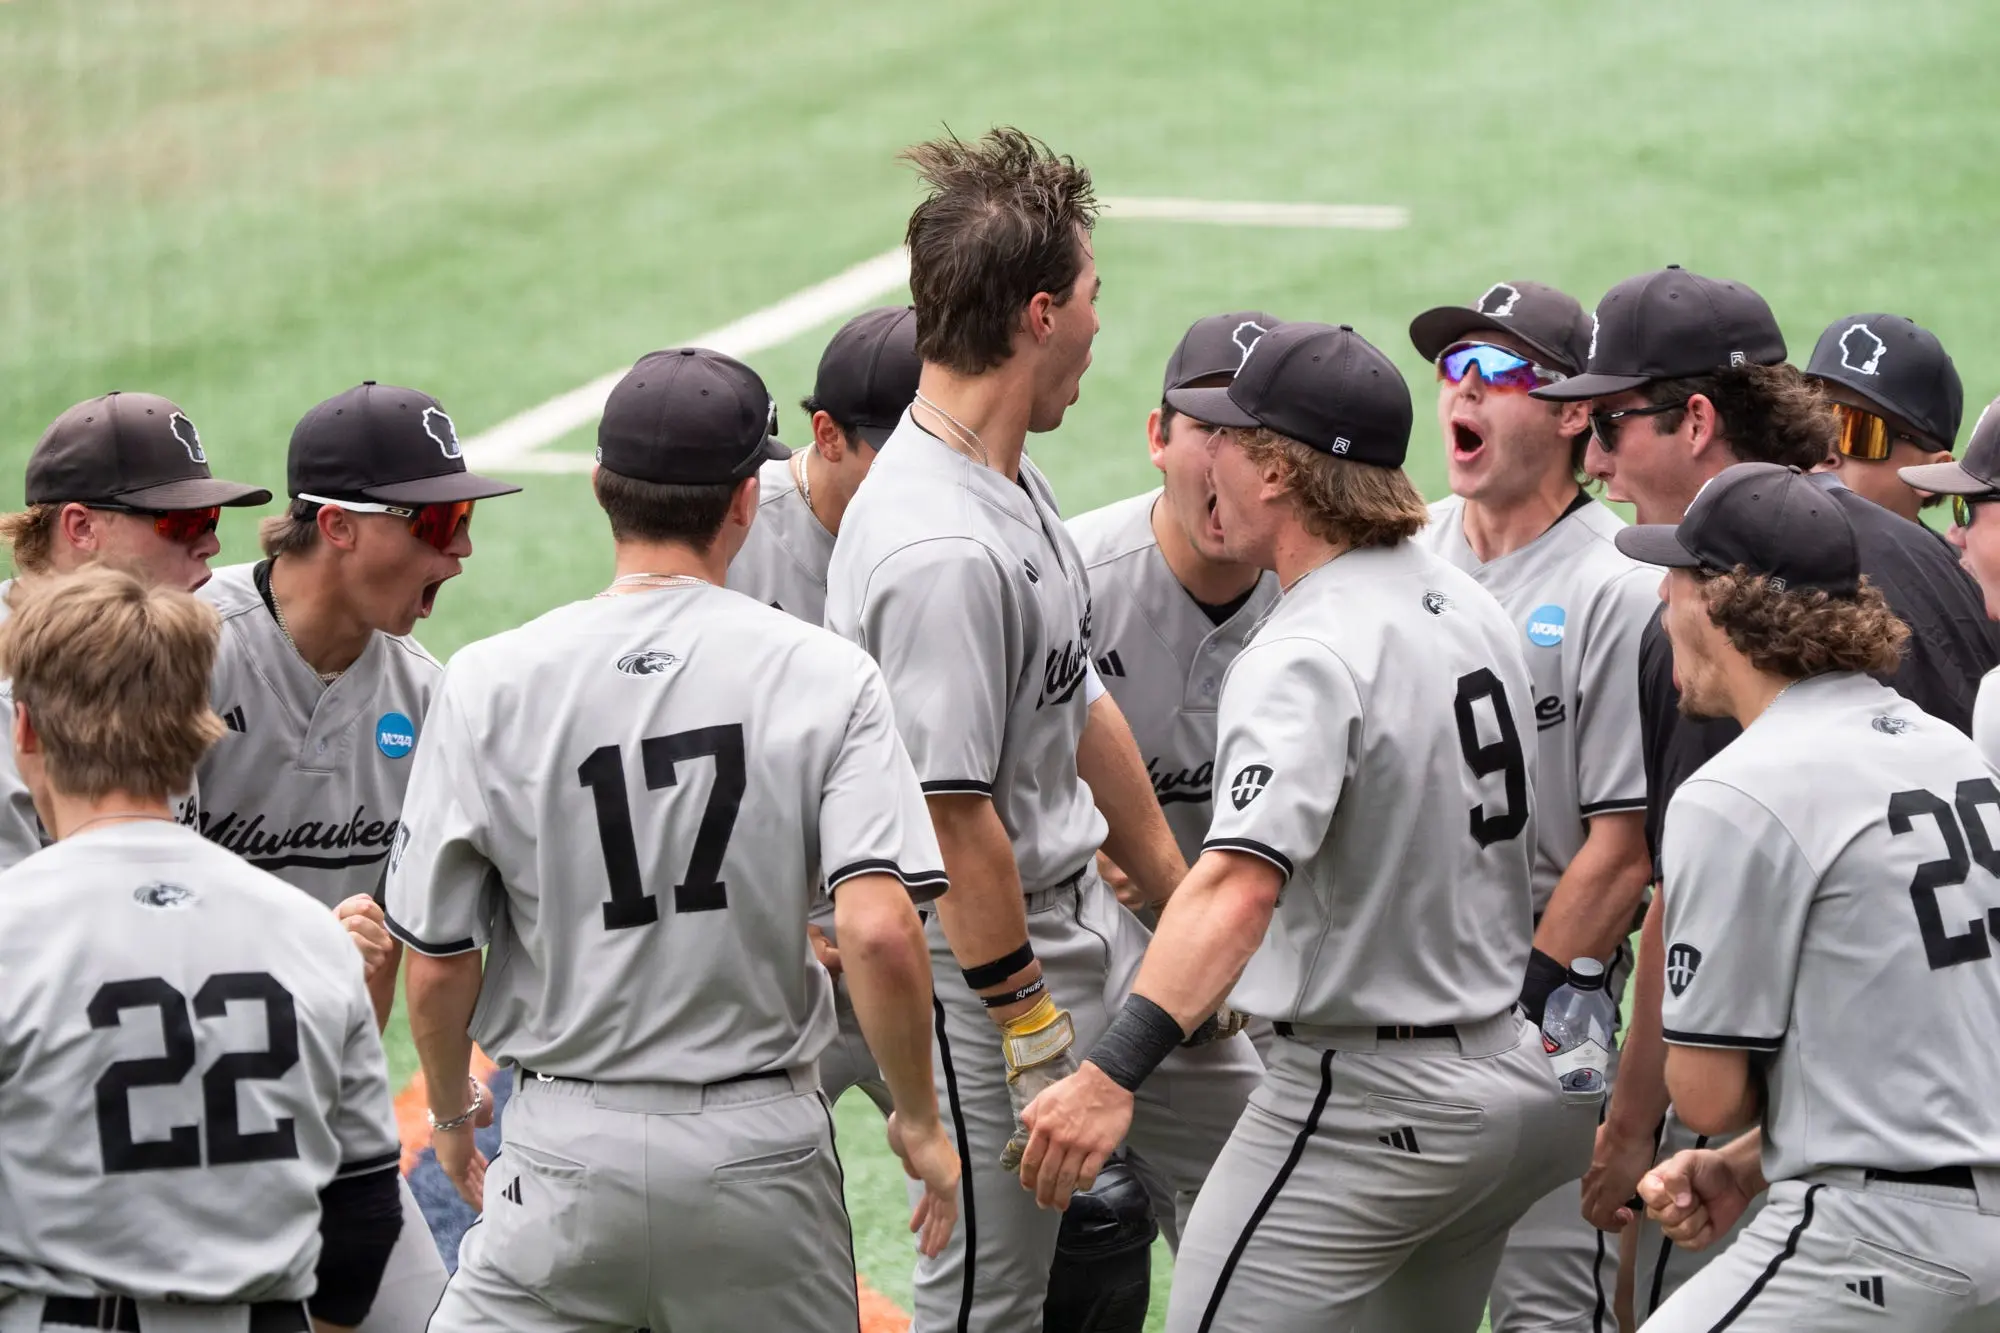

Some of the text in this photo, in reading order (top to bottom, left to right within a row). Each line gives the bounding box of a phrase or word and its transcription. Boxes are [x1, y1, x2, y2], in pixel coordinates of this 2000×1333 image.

[380, 732, 412, 747] NCAA
[578, 722, 747, 931] 17
[1453, 667, 1530, 849] 9
[199, 805, 400, 858] Milwaukee
[86, 972, 300, 1175] 22
